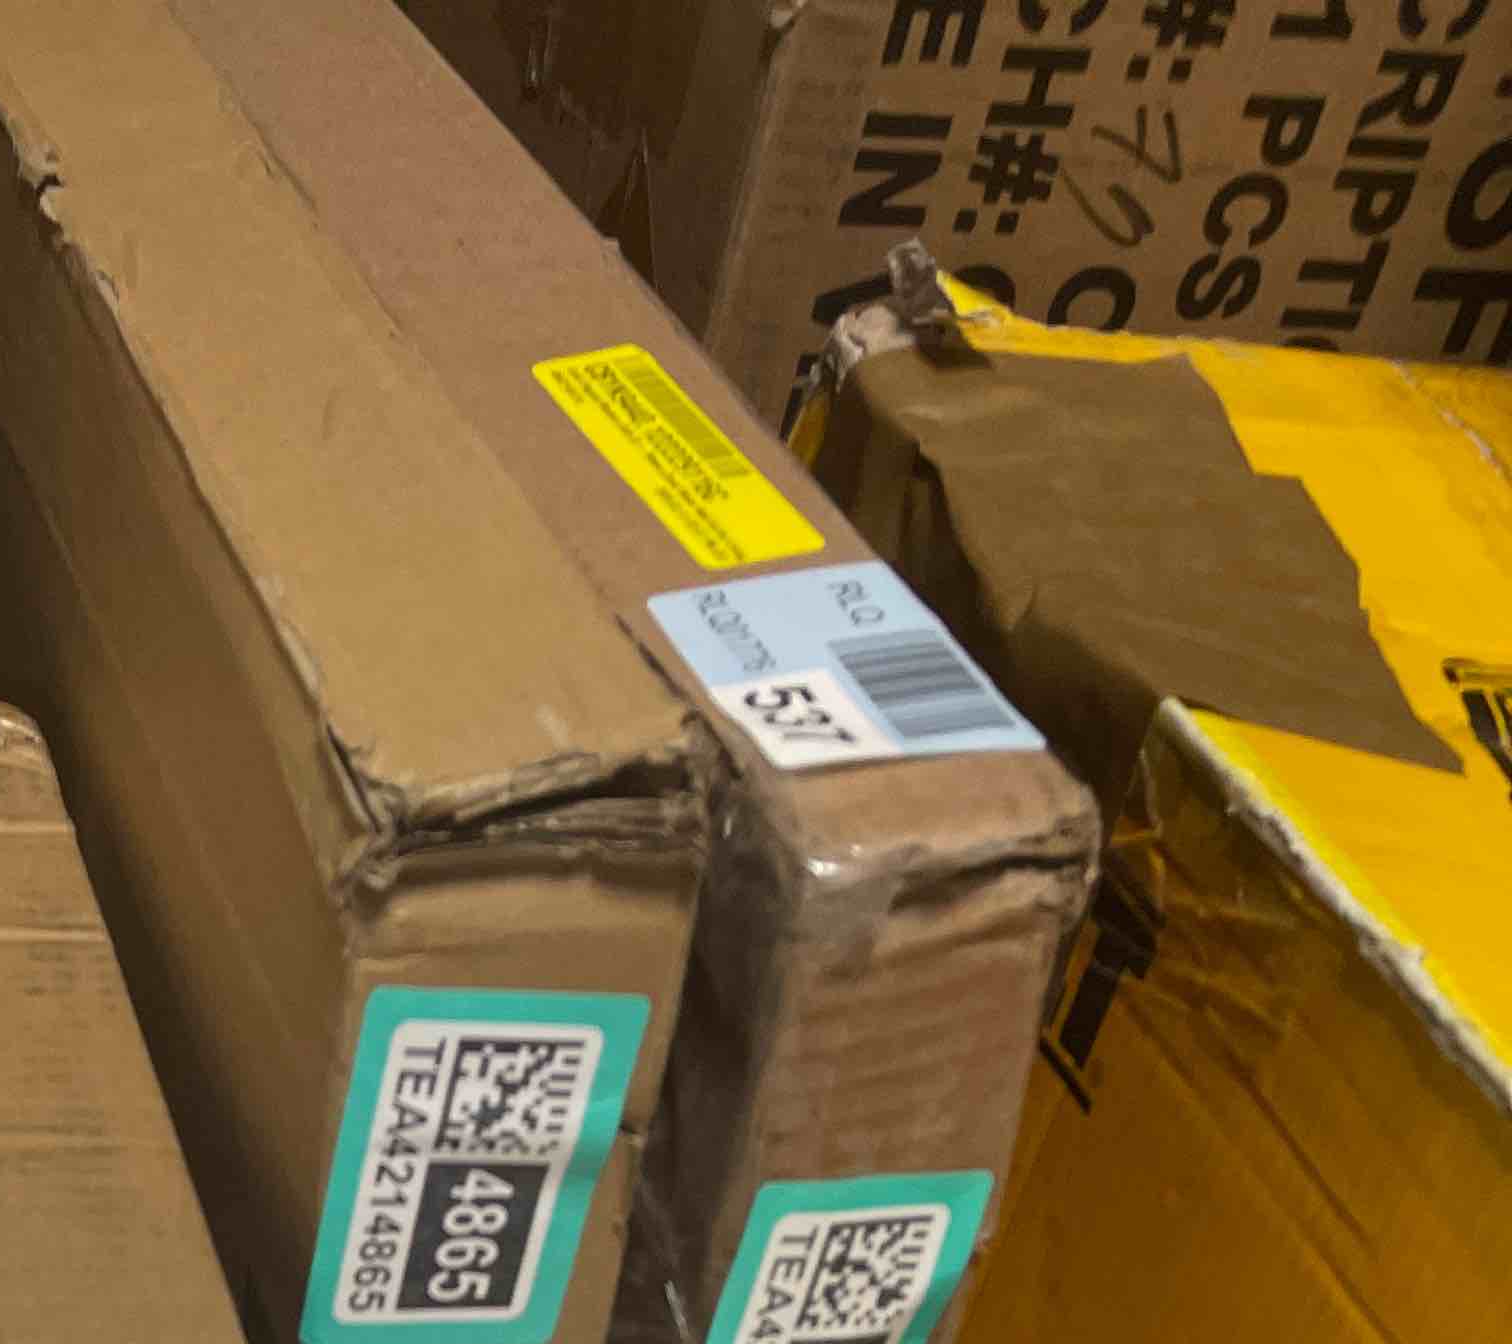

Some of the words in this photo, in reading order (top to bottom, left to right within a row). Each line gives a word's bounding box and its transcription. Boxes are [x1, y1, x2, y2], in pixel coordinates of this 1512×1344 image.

[837, 111, 953, 228] IN
[1175, 93, 1327, 322] PCS
[347, 1037, 446, 1314] TEA4214865
[426, 1167, 515, 1303] 4865
